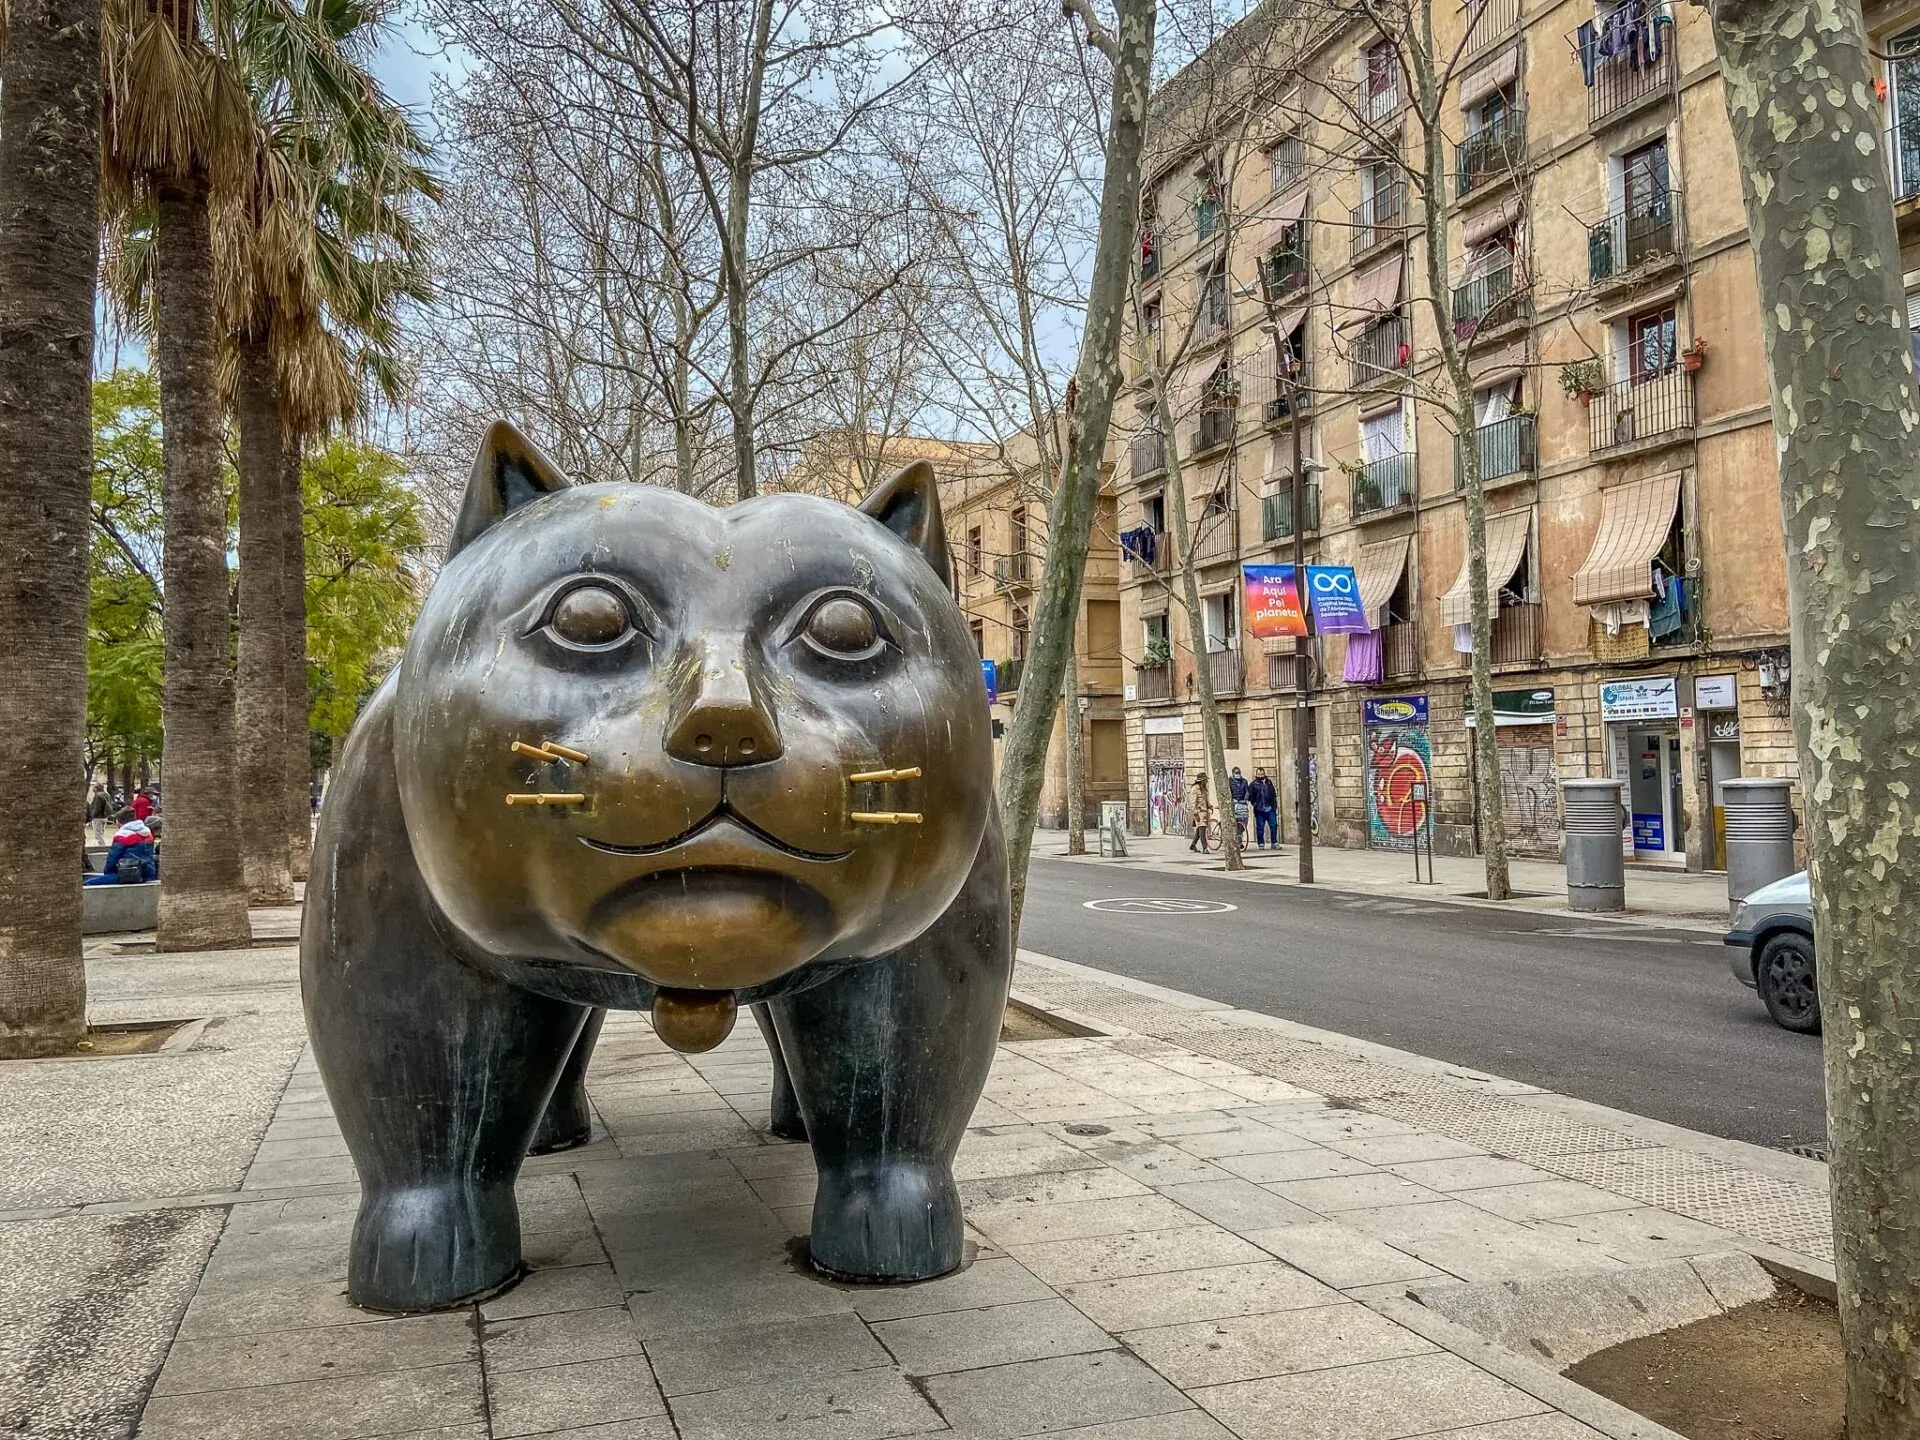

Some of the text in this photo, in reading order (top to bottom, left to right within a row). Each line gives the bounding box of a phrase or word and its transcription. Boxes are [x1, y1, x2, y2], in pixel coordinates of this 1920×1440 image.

[1263, 575, 1282, 584] Ara
[1268, 598, 1285, 608] Pel
[1256, 608, 1298, 621] planeta
[1611, 684, 1633, 692] GLOBAL
[1376, 706, 1399, 716] Shujah
